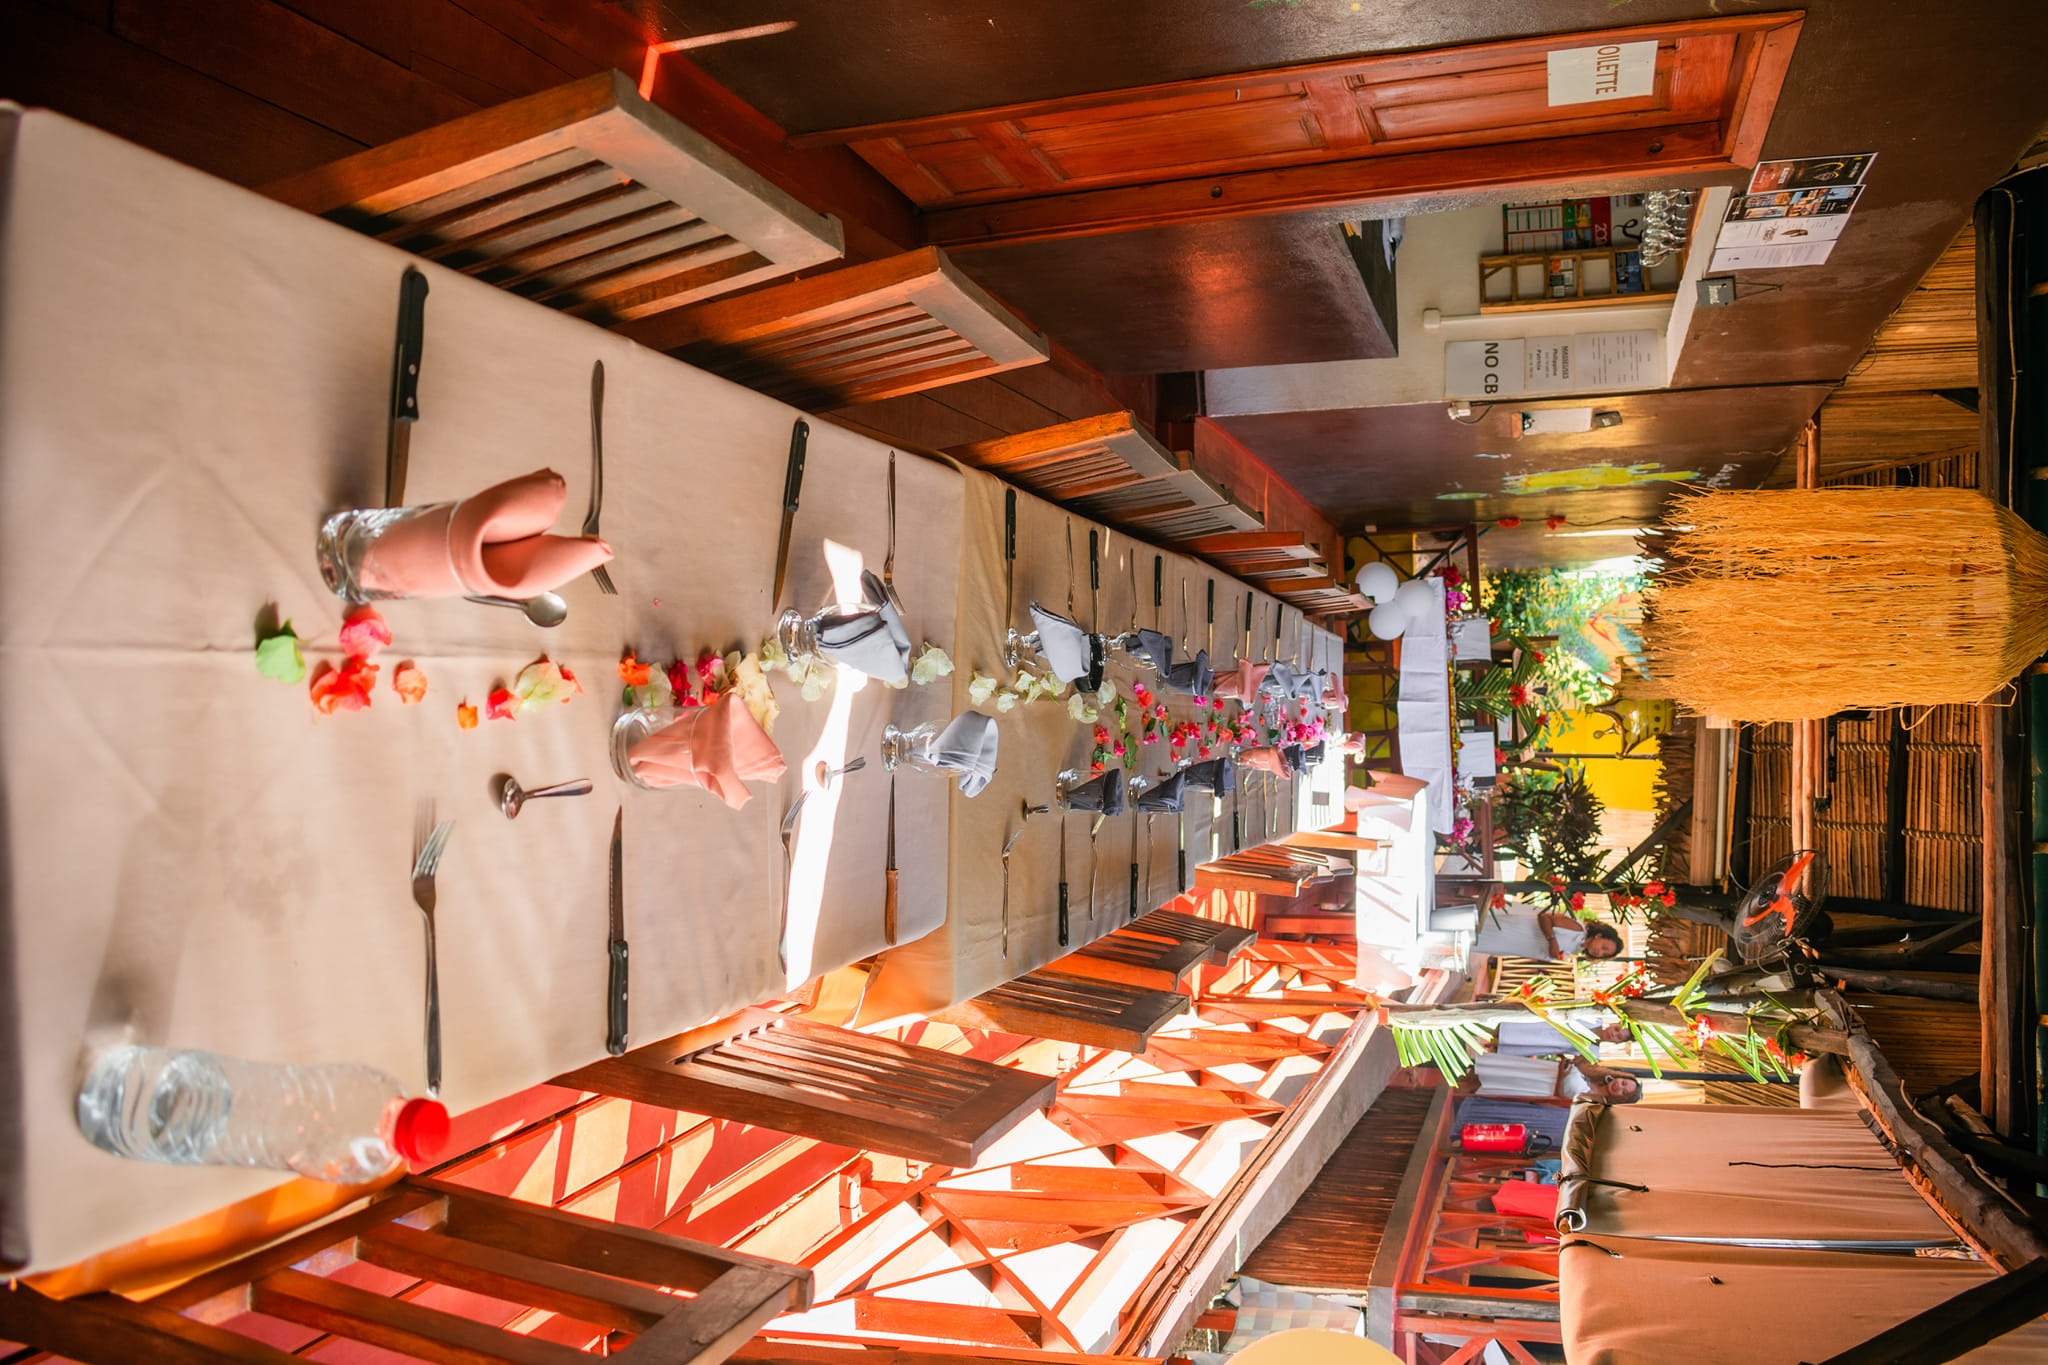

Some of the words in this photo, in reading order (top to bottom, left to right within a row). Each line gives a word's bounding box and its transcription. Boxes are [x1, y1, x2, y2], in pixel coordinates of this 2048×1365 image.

[1595, 45, 1621, 95] OILETTE
[1484, 342, 1500, 368] NO
[1484, 373, 1499, 395] CB
